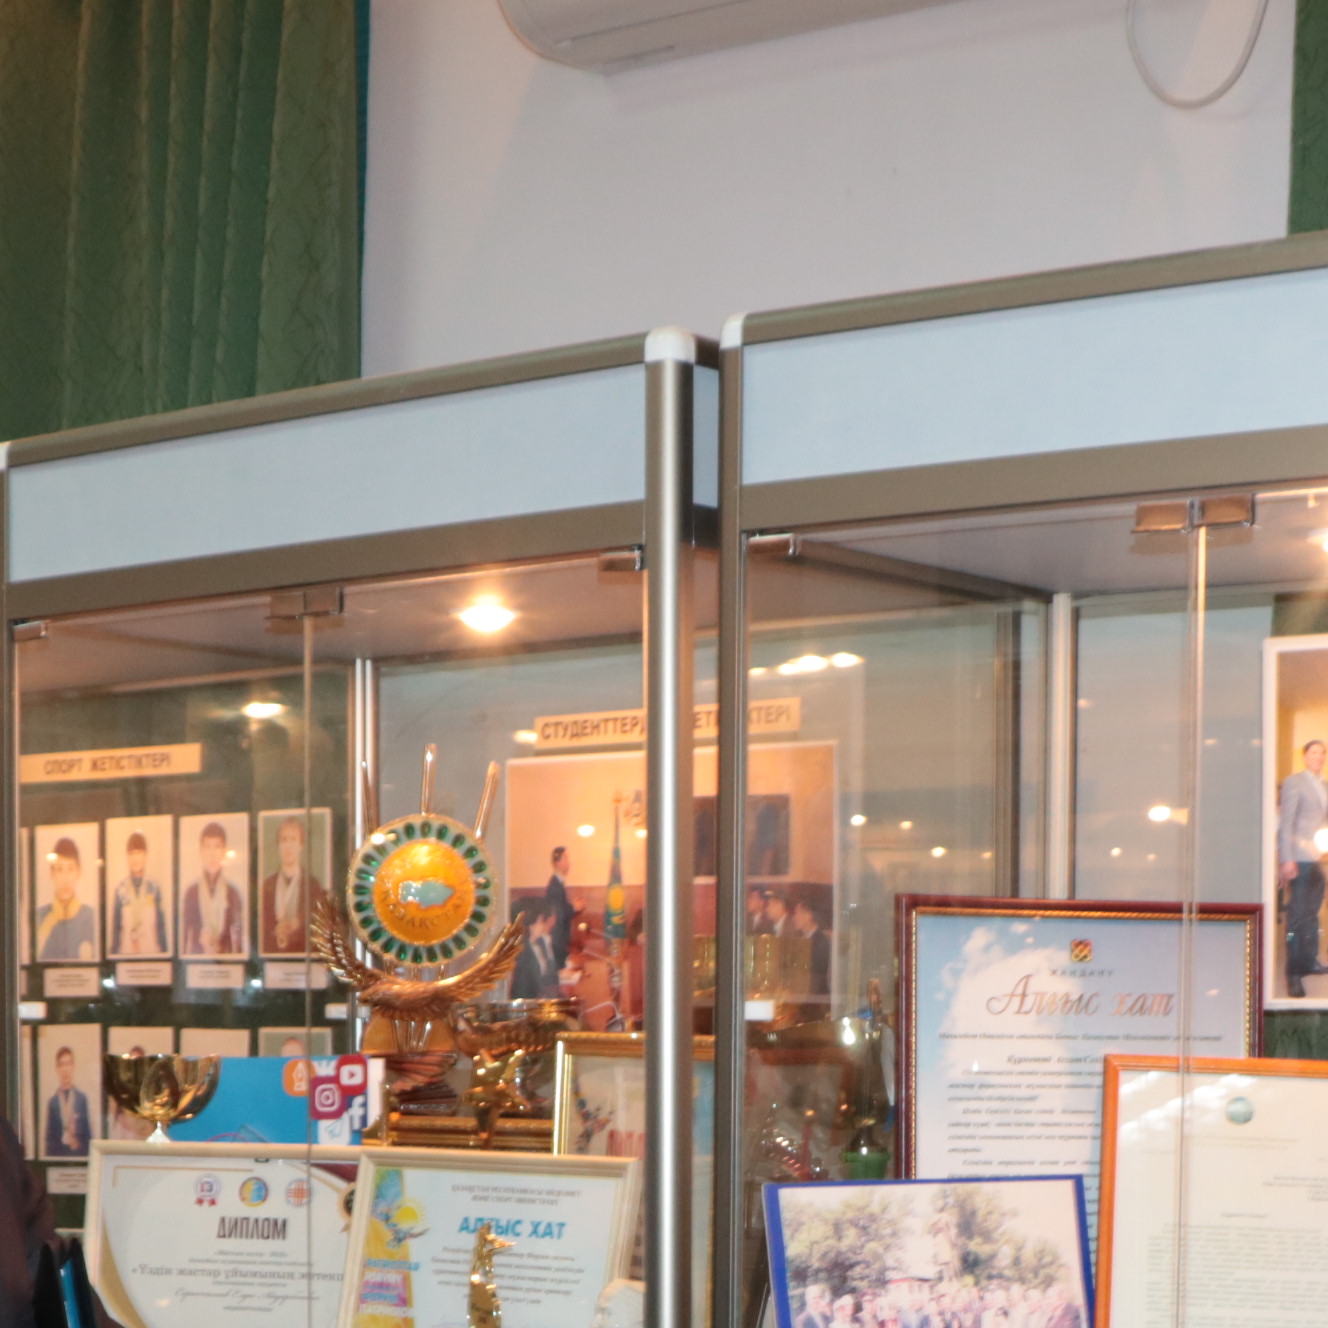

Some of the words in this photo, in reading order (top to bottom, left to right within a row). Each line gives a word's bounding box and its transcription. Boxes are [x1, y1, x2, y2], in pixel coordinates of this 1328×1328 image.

[43, 758, 83, 776] СПОРТ
[1108, 991, 1177, 1017] хат
[216, 1215, 288, 1241] ДИПЛОМ
[527, 1220, 568, 1240] ХАТ
